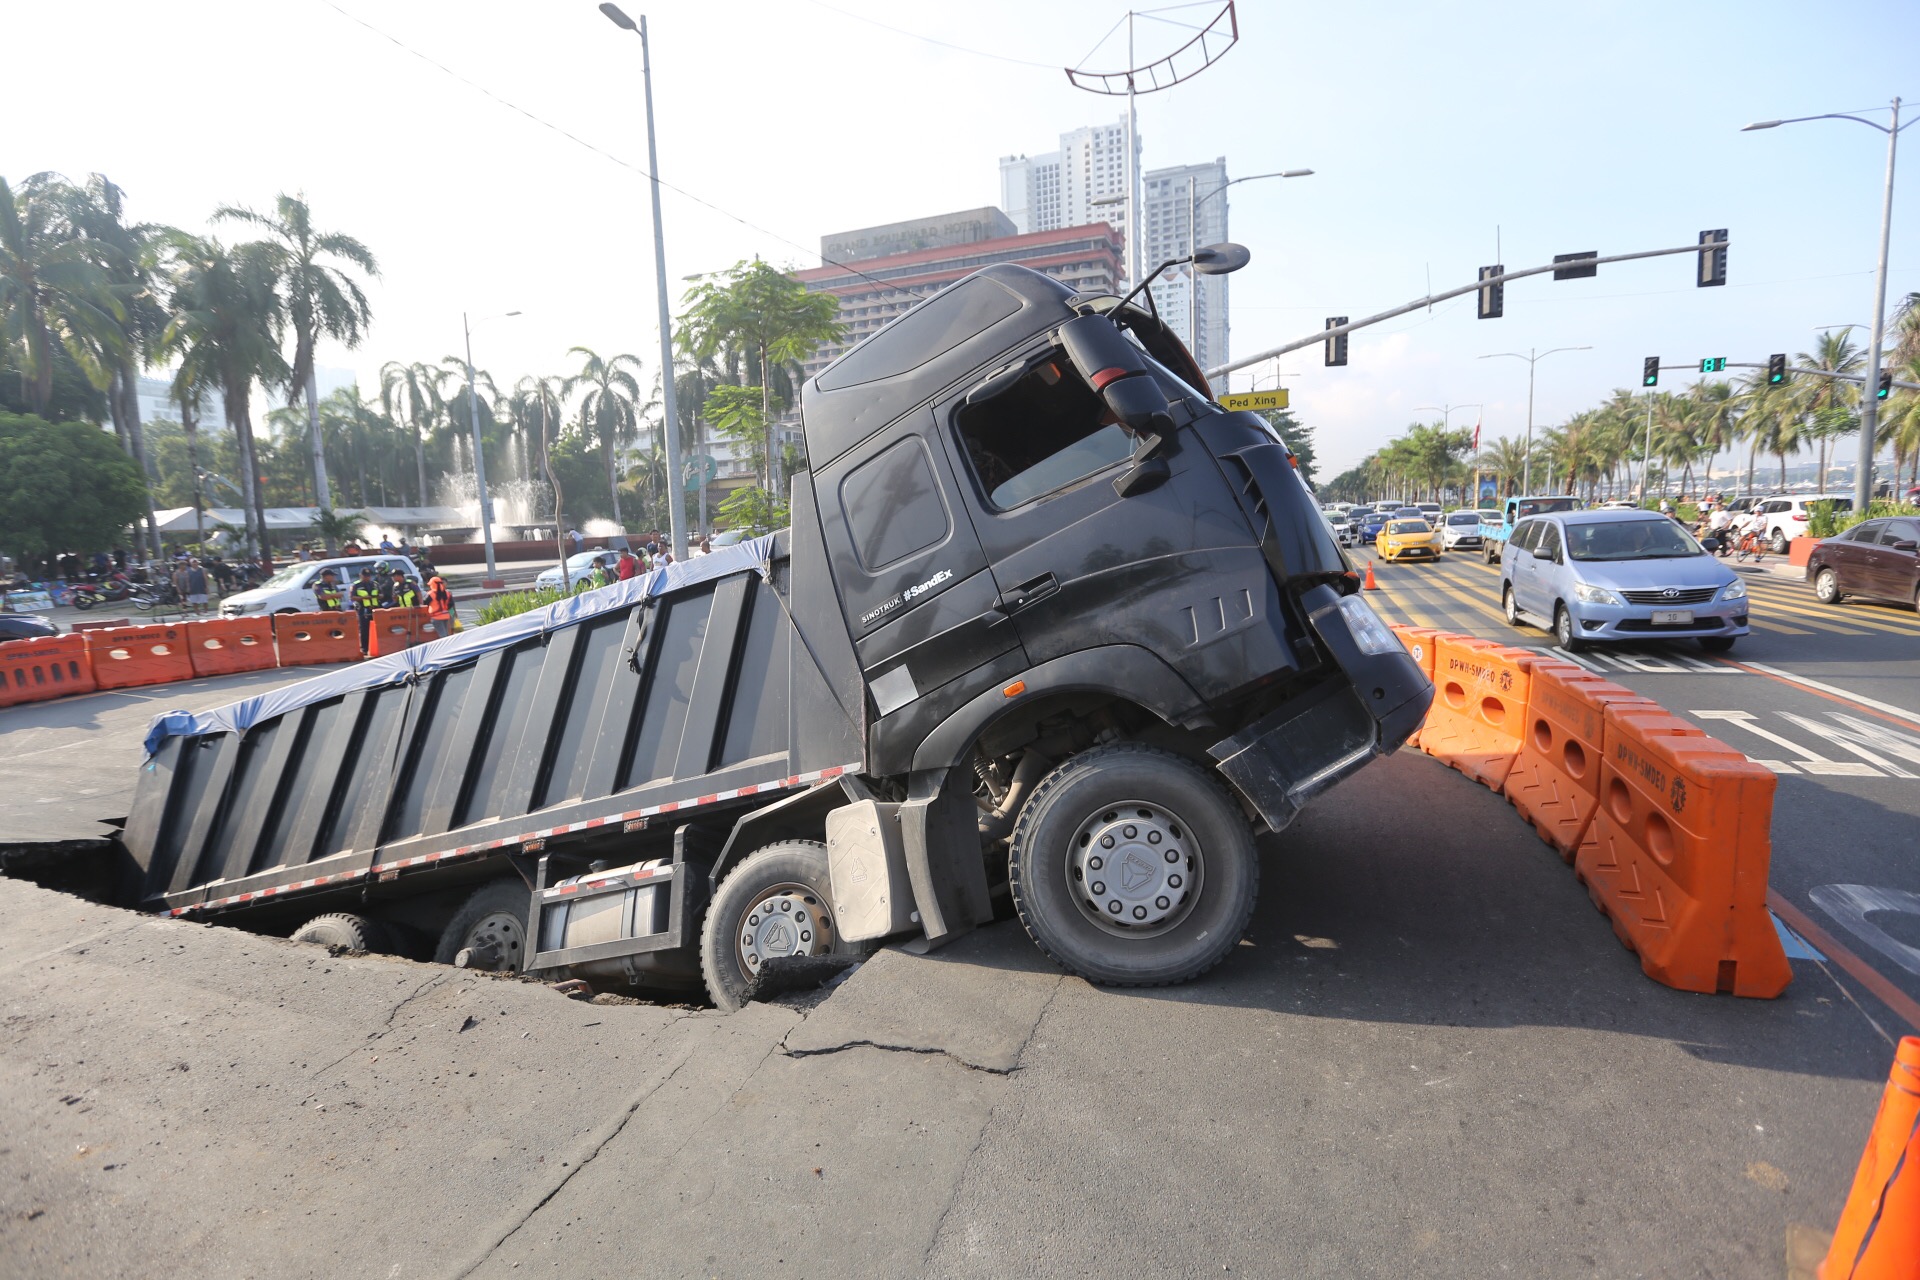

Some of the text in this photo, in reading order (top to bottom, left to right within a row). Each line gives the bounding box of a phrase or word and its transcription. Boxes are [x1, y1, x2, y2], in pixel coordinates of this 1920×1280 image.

[828, 238, 868, 253] GRAND
[1703, 358, 1725, 371] 81
[1229, 396, 1276, 407] Ped Xing
[861, 568, 953, 623] SINOTRUK #SandEx
[1617, 743, 1666, 793] DPWH-SMDEO
